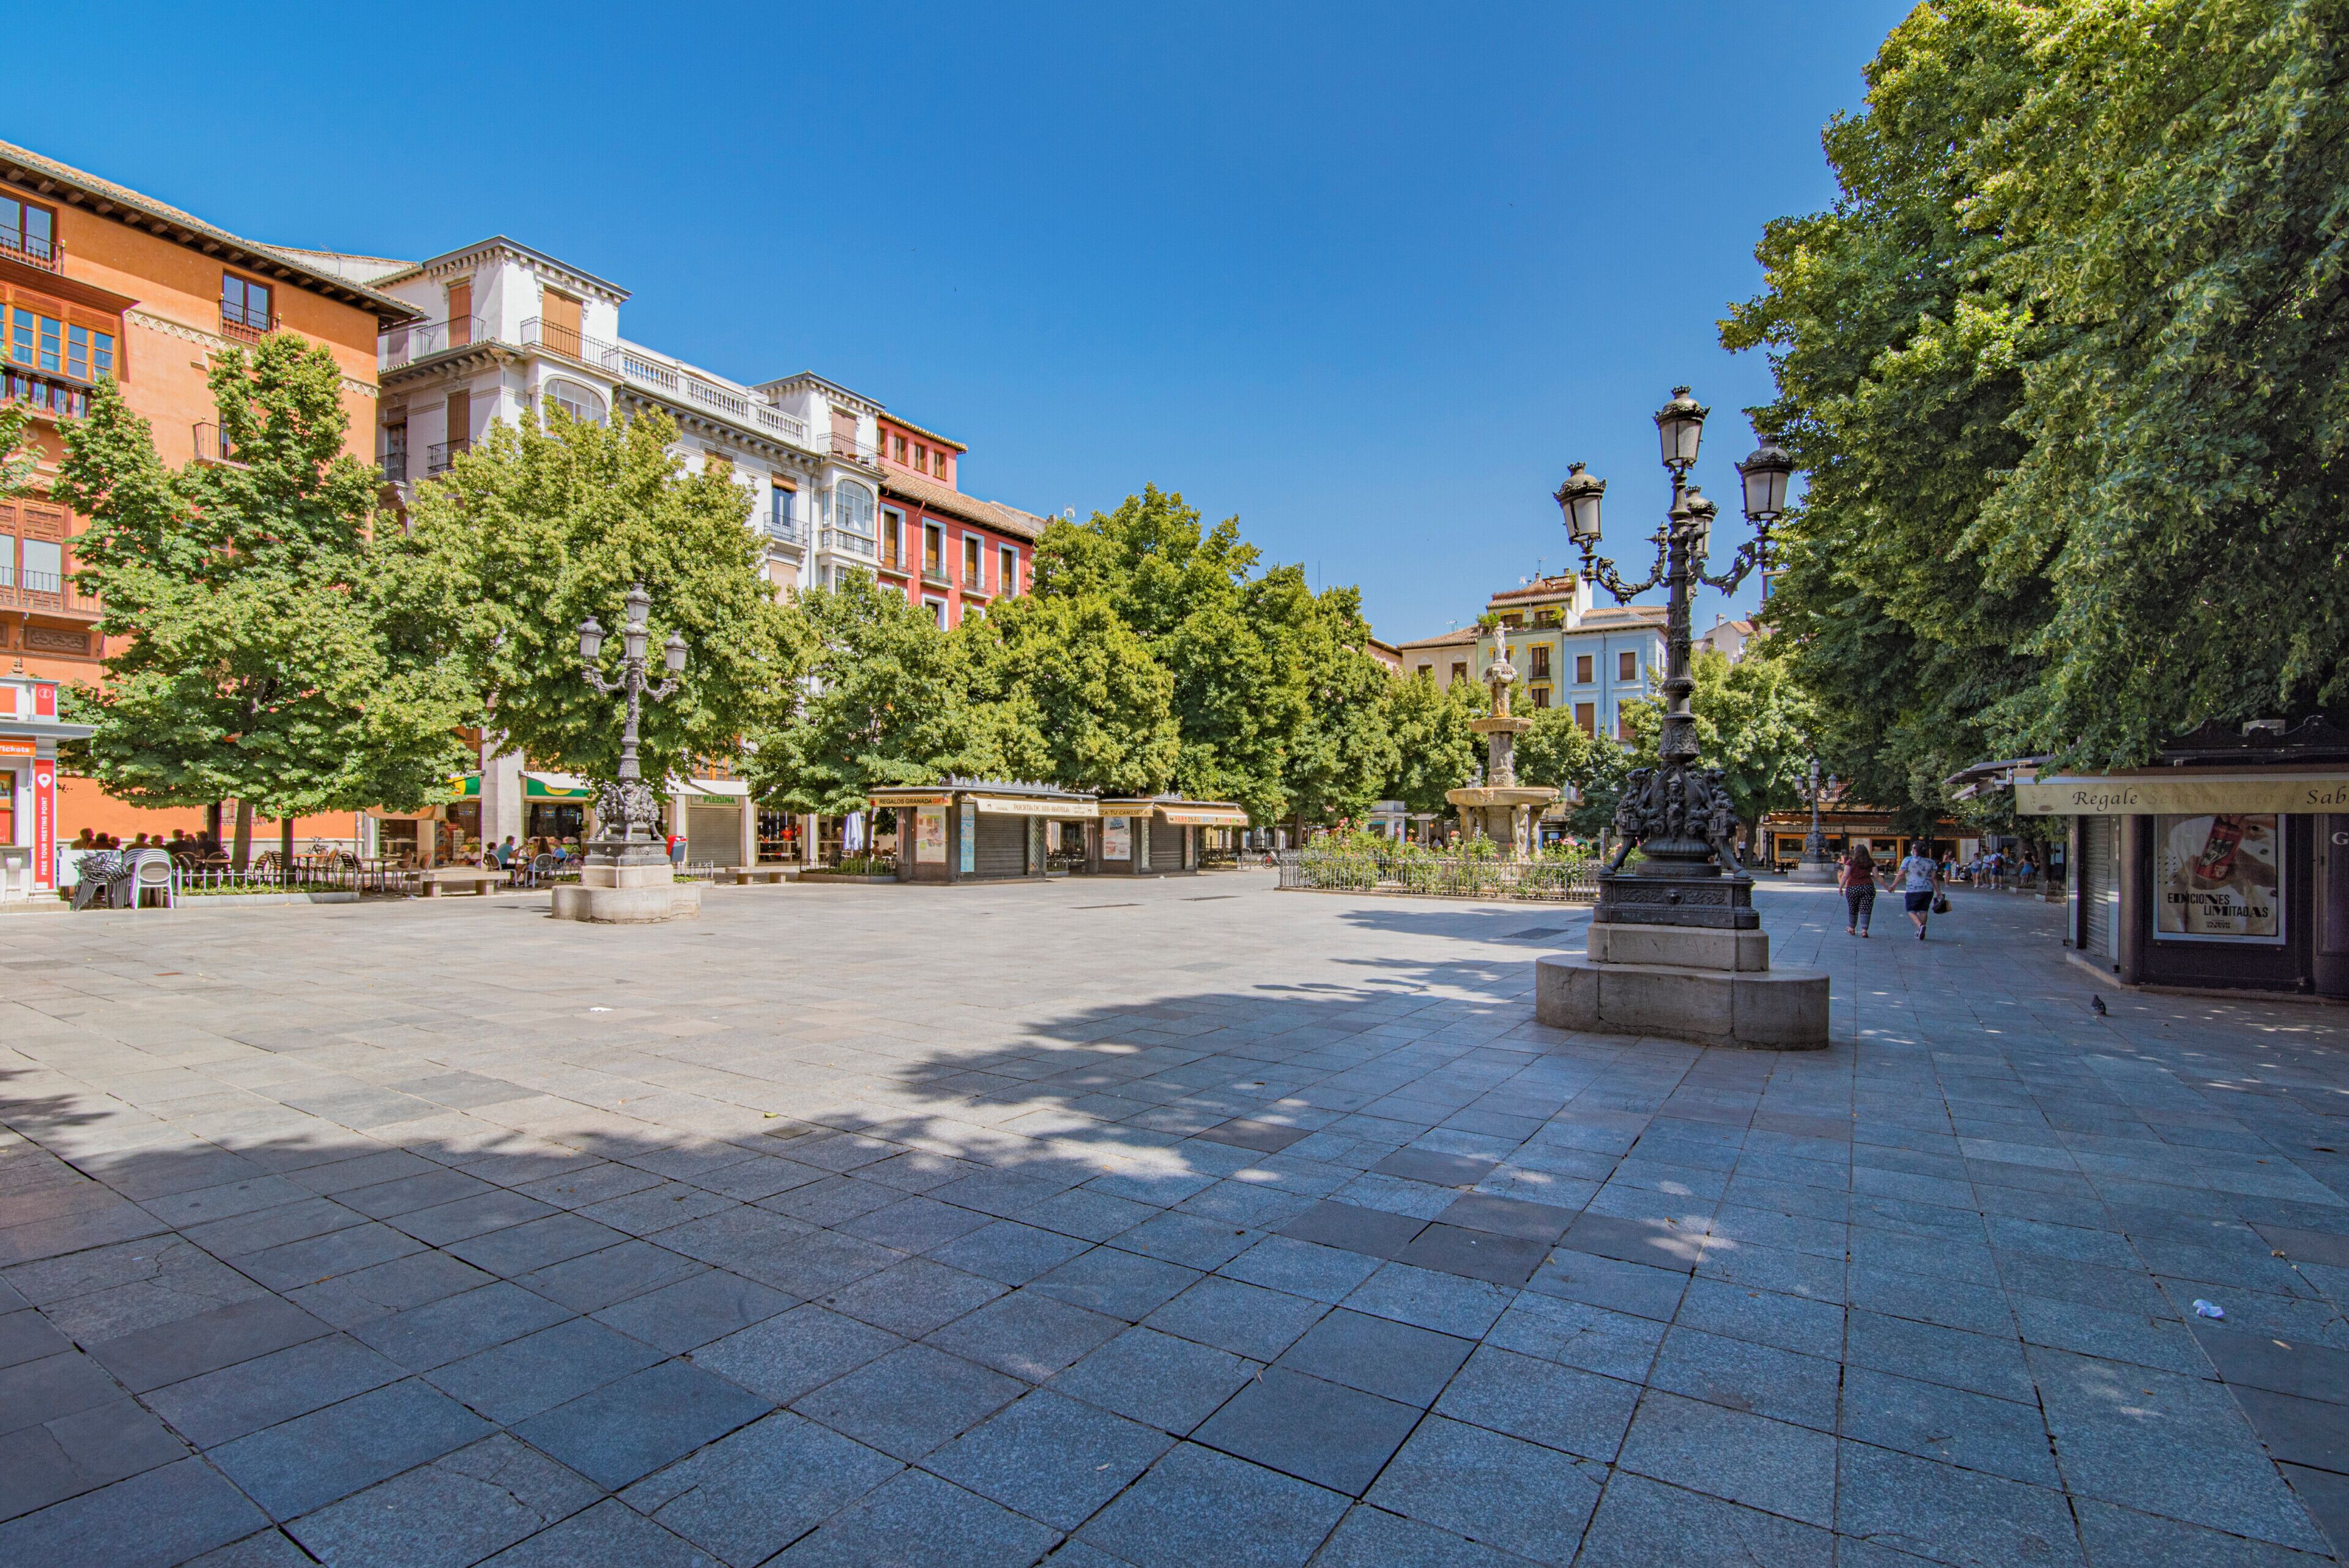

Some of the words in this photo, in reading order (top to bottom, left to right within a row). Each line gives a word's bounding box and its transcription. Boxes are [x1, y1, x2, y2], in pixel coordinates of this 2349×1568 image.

[2072, 787, 2138, 812] Regale
[2306, 786, 2349, 804] Sab
[2167, 893, 2230, 905] EDICIONES
[2203, 905, 2268, 918] LIMITADAS
